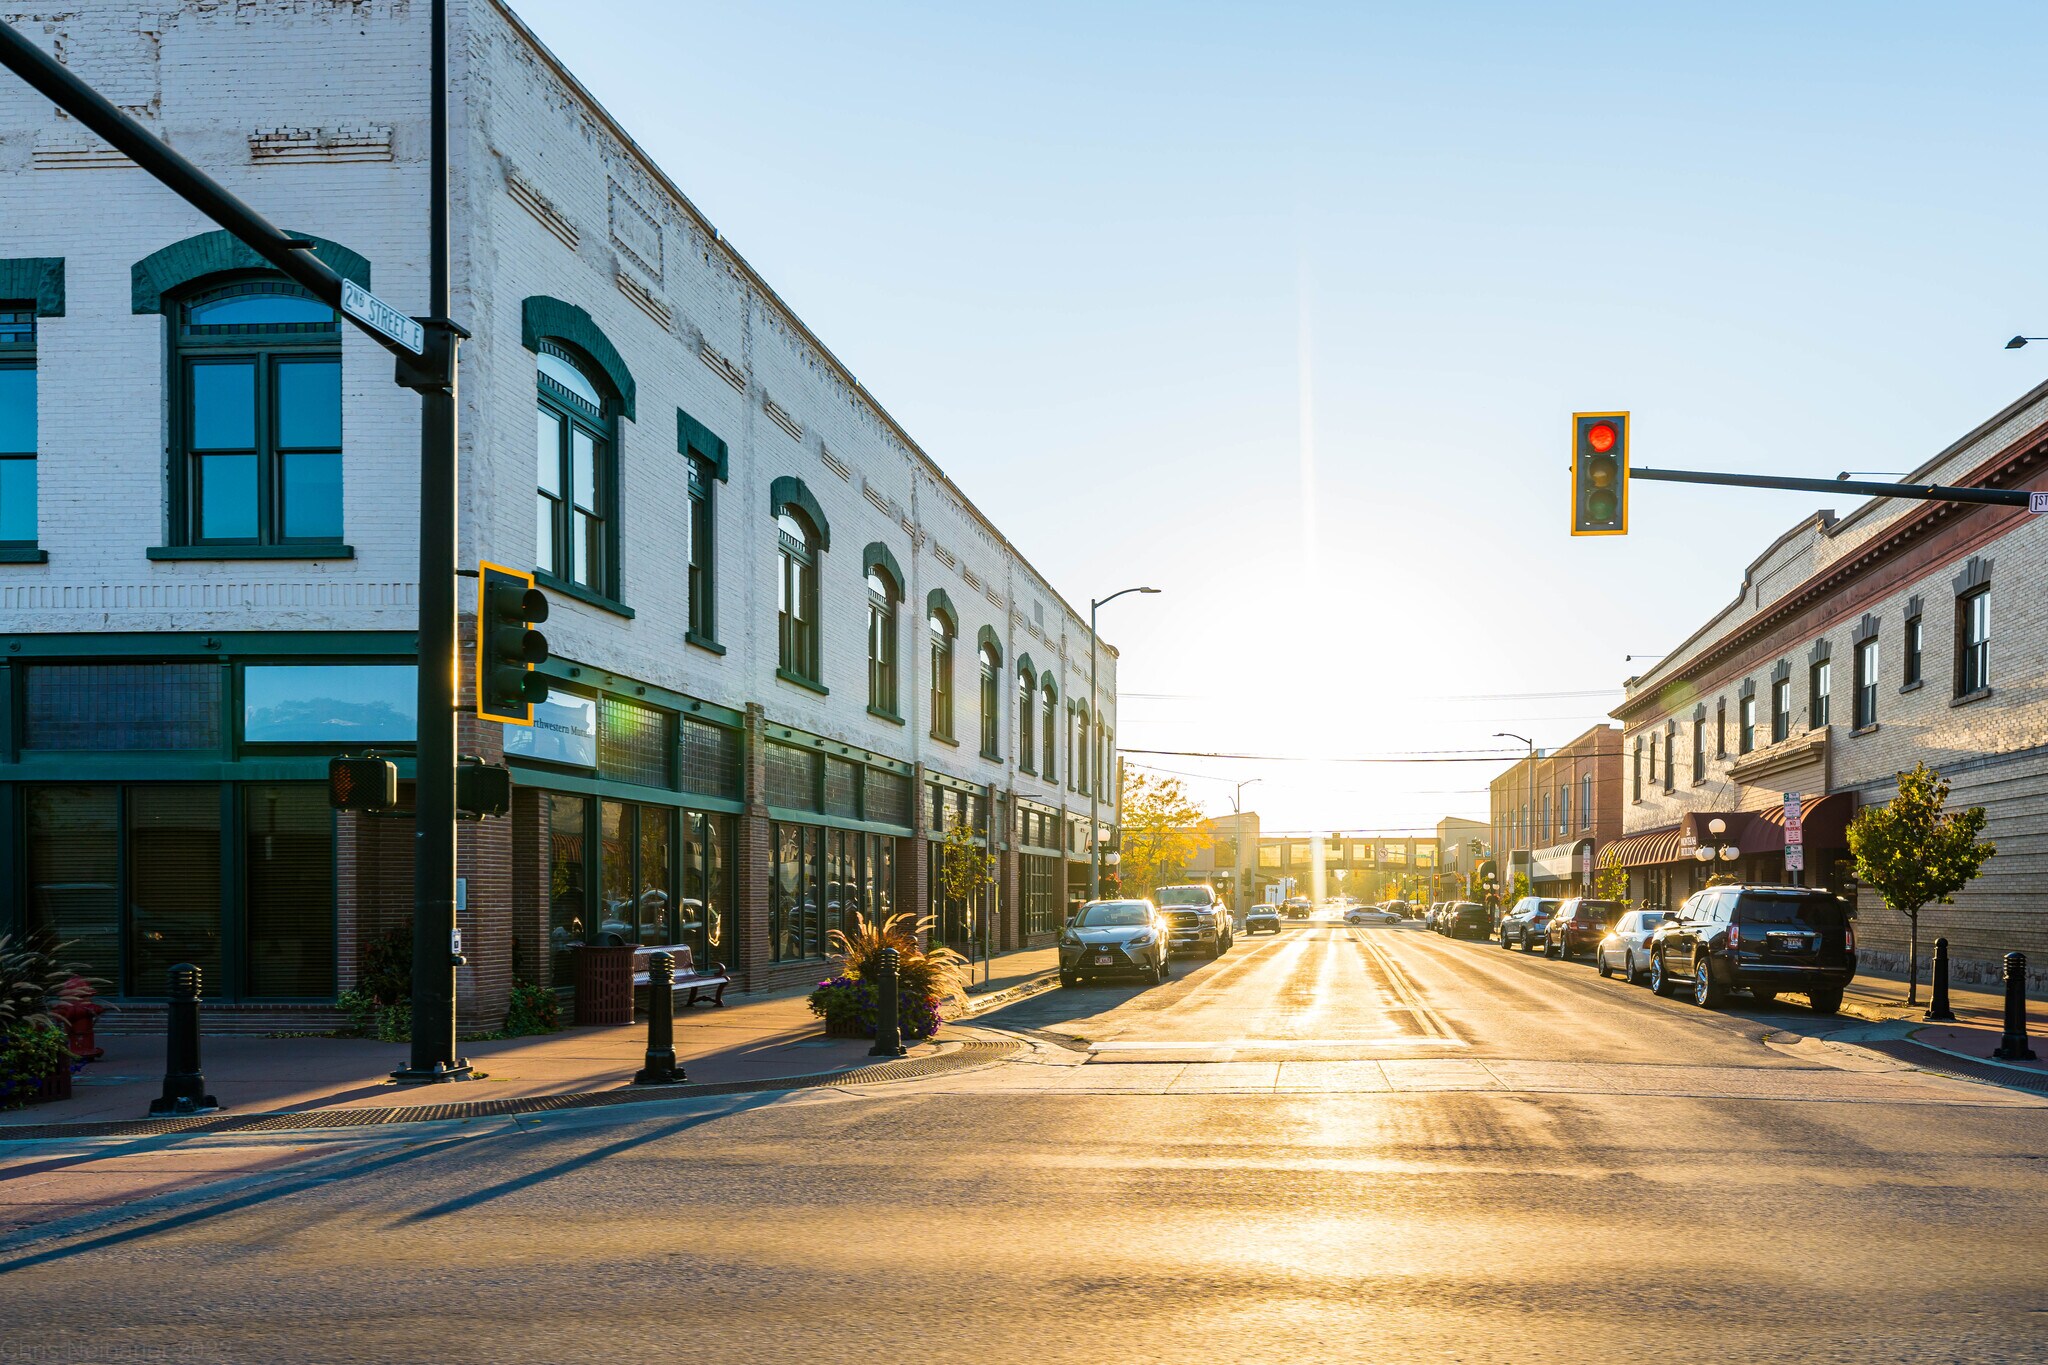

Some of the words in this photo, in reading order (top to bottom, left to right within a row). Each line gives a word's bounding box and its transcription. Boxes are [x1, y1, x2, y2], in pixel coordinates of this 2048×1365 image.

[368, 300, 405, 339] STREET
[414, 328, 420, 348] E
[533, 718, 570, 733] rthwestern
